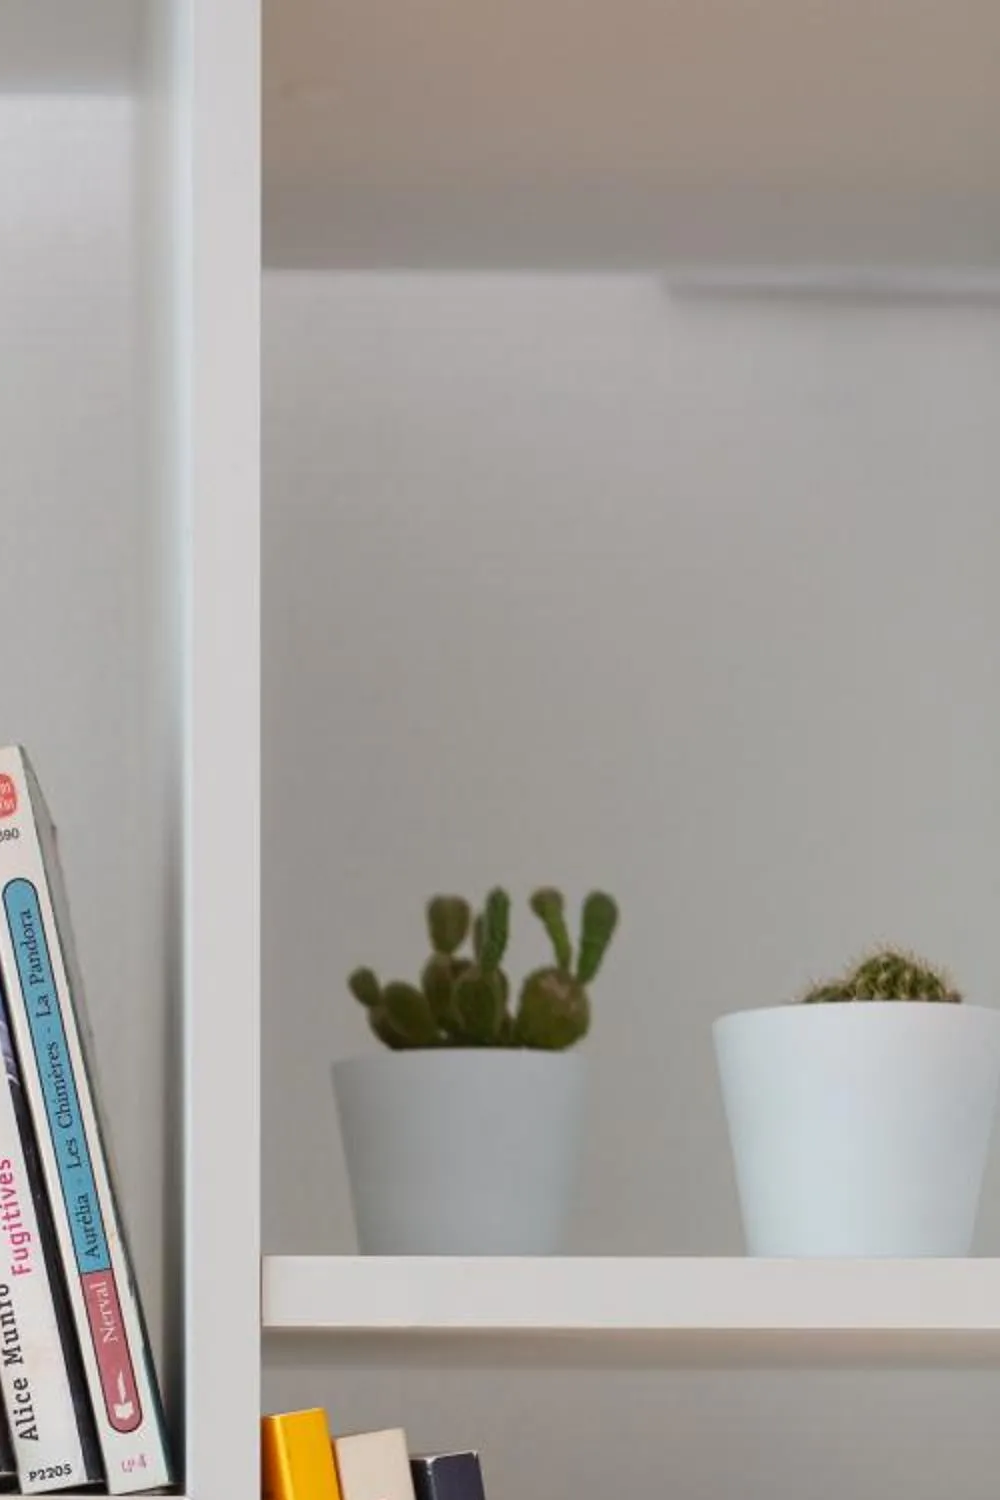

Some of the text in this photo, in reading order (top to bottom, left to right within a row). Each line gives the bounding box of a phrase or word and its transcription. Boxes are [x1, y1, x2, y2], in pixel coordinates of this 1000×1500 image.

[20, 909, 101, 1259] Aurélia Les Chimères La Pandora
[89, 1280, 118, 1344] Nerval
[13, 1378, 39, 1442] Alice
[29, 1464, 72, 1482] P2205
